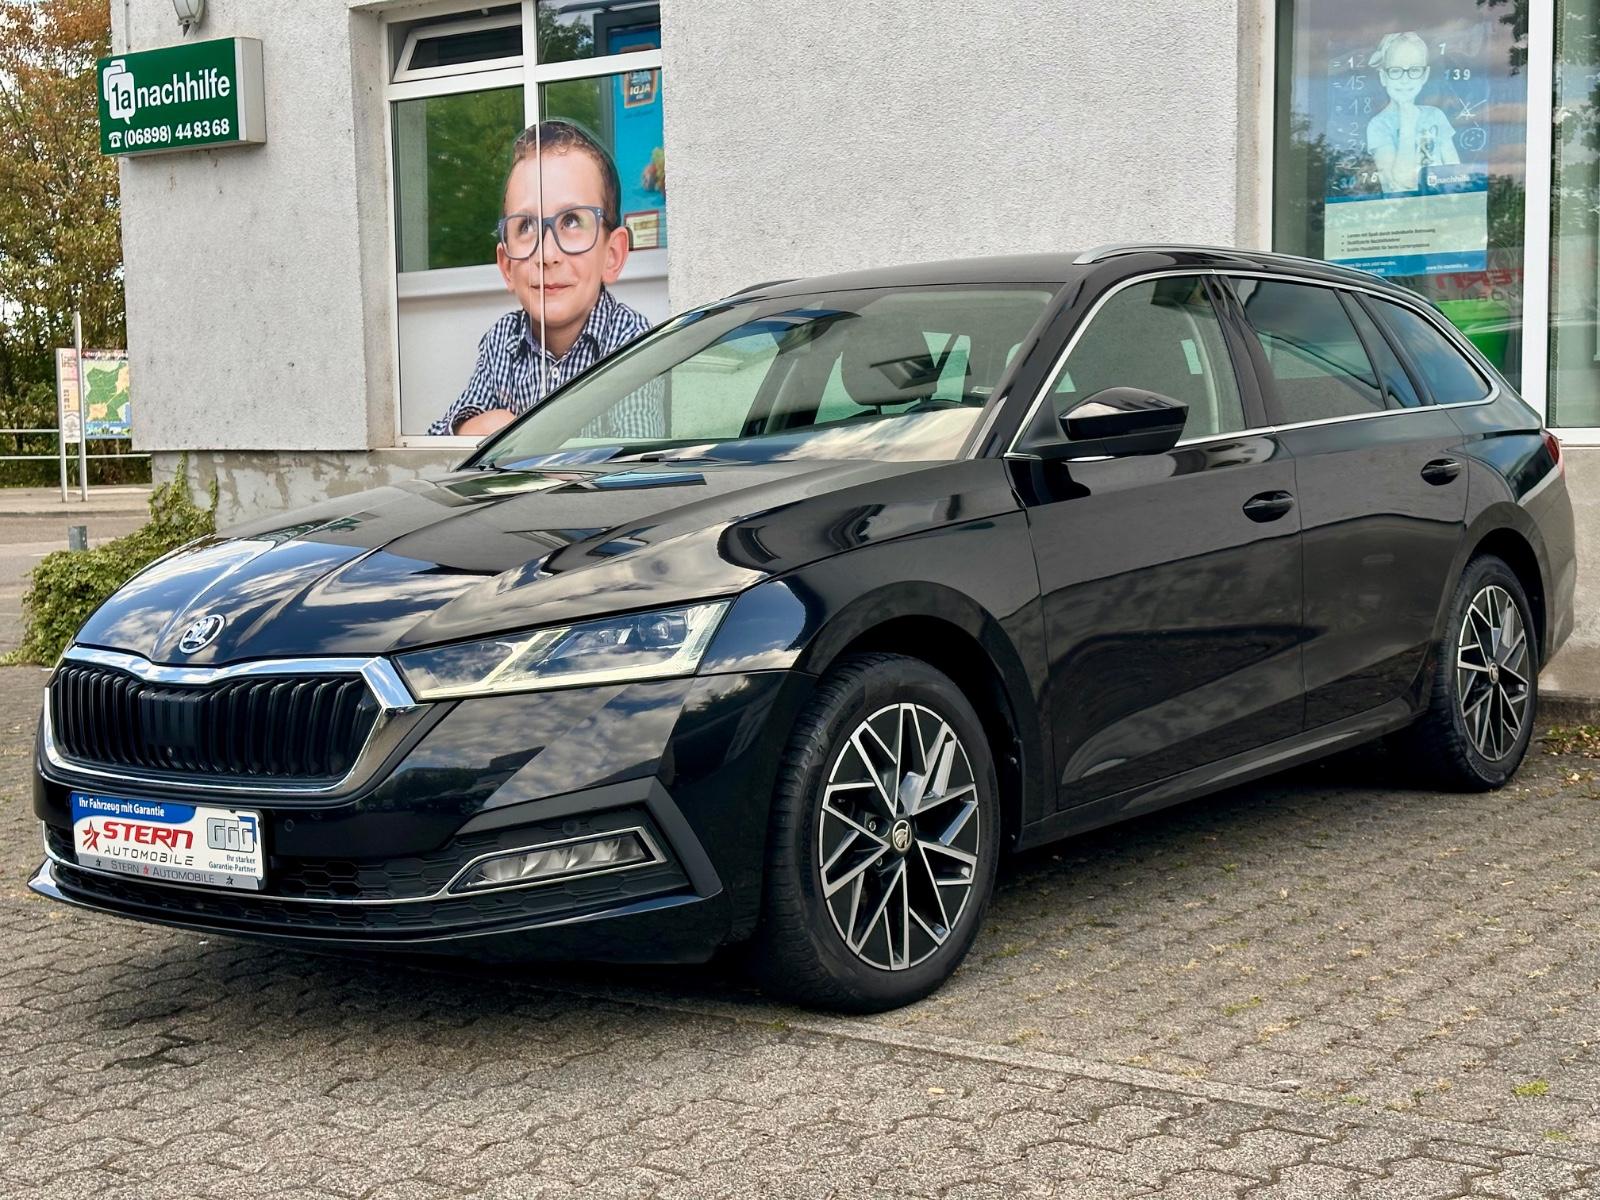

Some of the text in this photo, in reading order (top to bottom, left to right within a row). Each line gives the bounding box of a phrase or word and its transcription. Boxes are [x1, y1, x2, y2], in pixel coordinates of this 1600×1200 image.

[124, 124, 171, 148] (06898)
[79, 797, 165, 817] Ihr Fahrzeug mit Garantie
[103, 821, 194, 853] STERN
[104, 846, 195, 866] AUTOMOBILE
[226, 854, 256, 865] Ihr starker
[208, 860, 257, 874] Garantie-Partner
